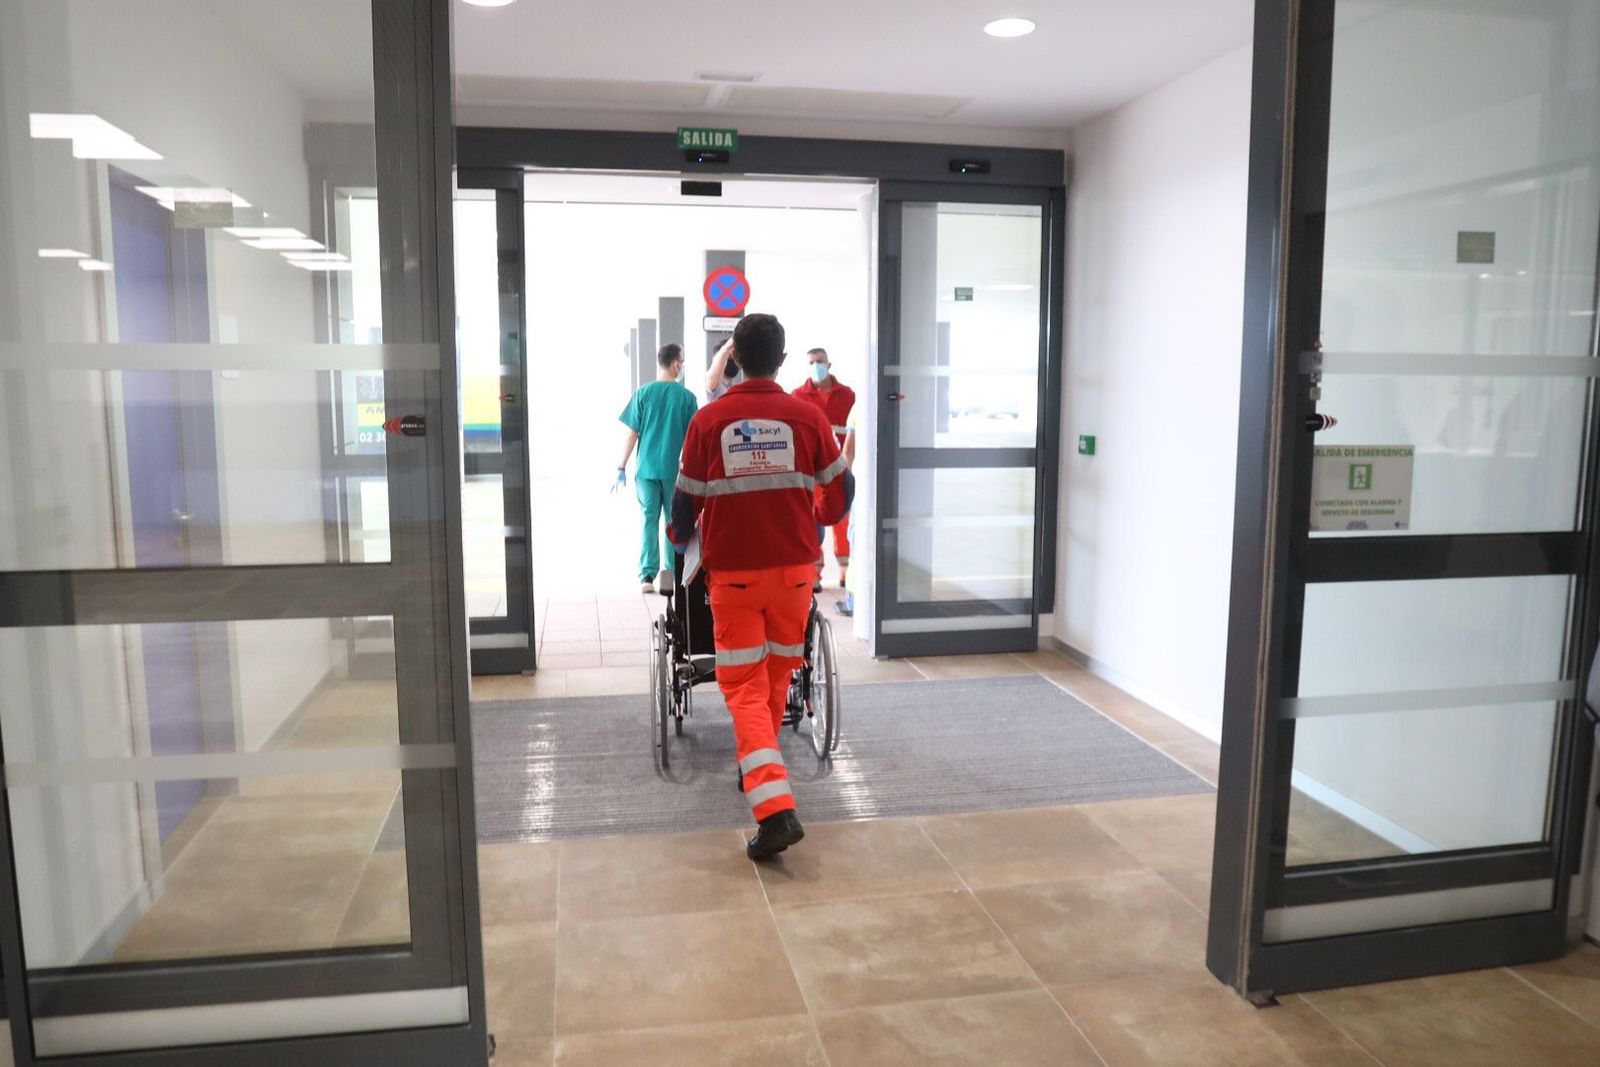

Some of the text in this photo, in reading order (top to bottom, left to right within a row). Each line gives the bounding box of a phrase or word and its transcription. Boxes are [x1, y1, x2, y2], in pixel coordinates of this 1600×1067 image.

[683, 131, 733, 147] SALIDA
[758, 427, 781, 435] Sacyl
[751, 451, 766, 460] 112
[1344, 448, 1356, 457] DE
[1357, 447, 1413, 457] EMERGENCIA
